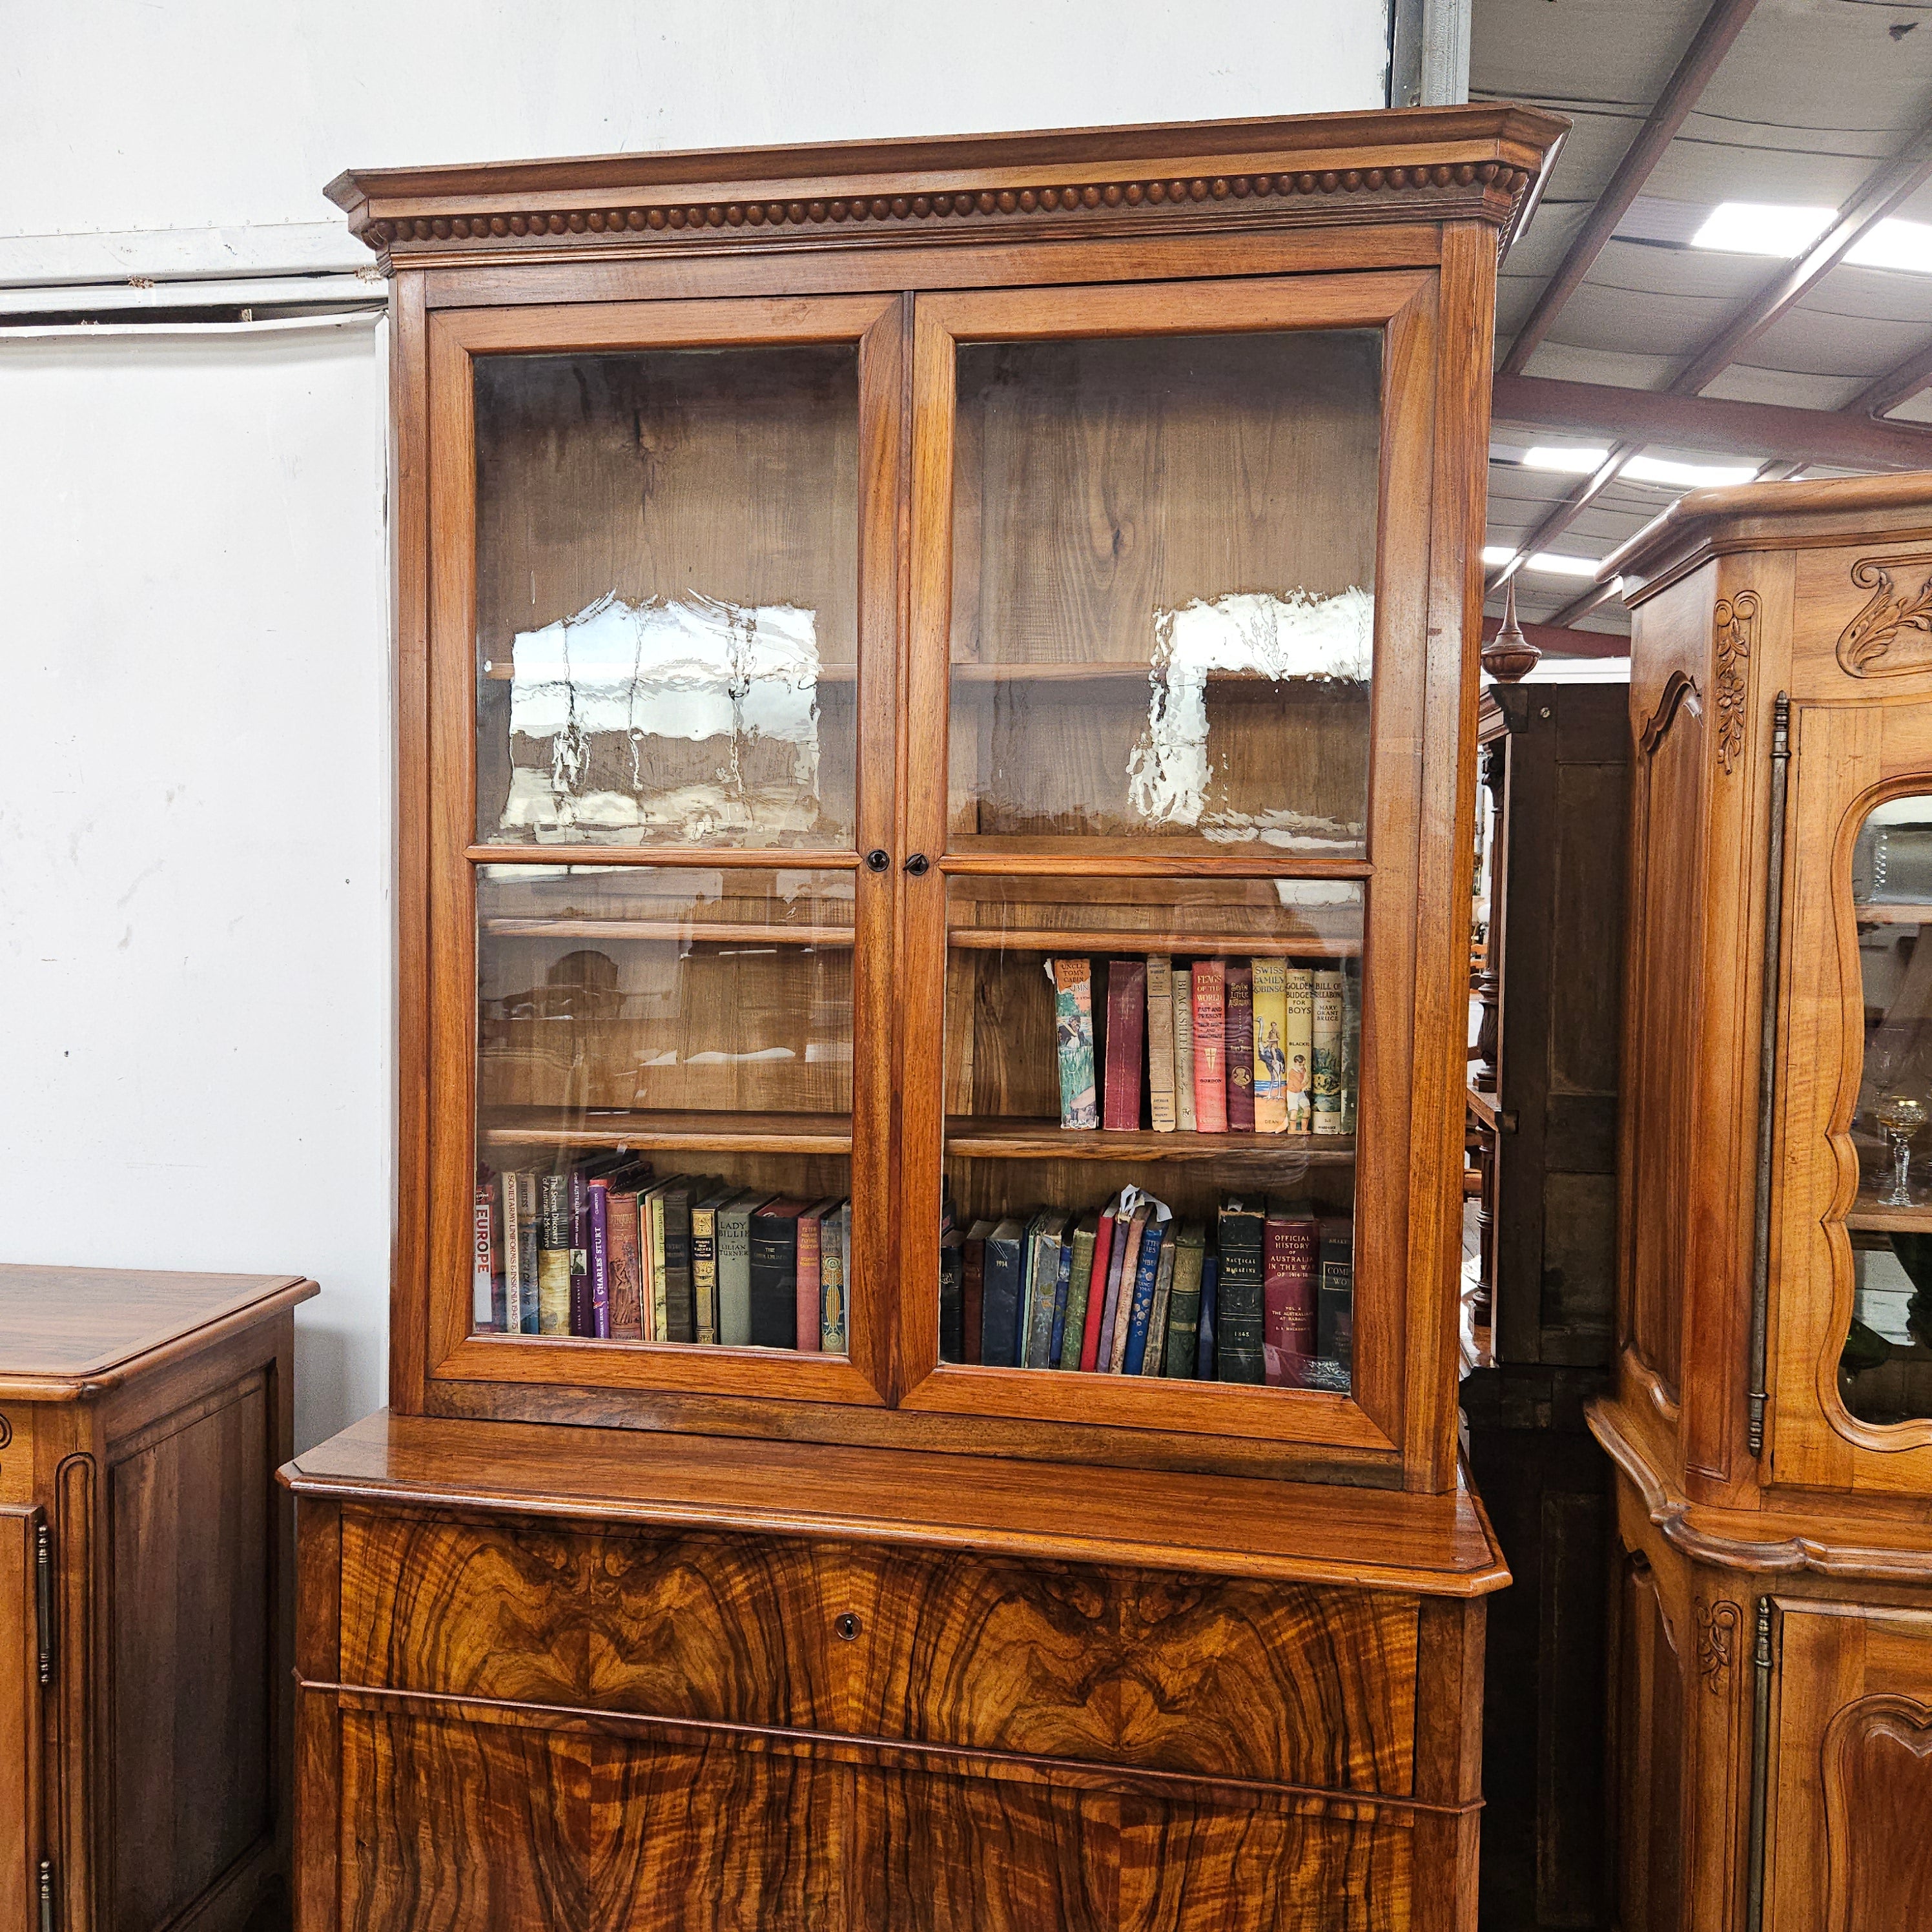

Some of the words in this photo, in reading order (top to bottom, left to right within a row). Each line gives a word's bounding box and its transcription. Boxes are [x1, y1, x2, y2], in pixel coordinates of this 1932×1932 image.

[1254, 976, 1285, 984] FAMILY
[1178, 980, 1187, 1015] BLACK
[1178, 1018, 1187, 1052] SHEEP
[477, 1209, 489, 1273] EUROPE
